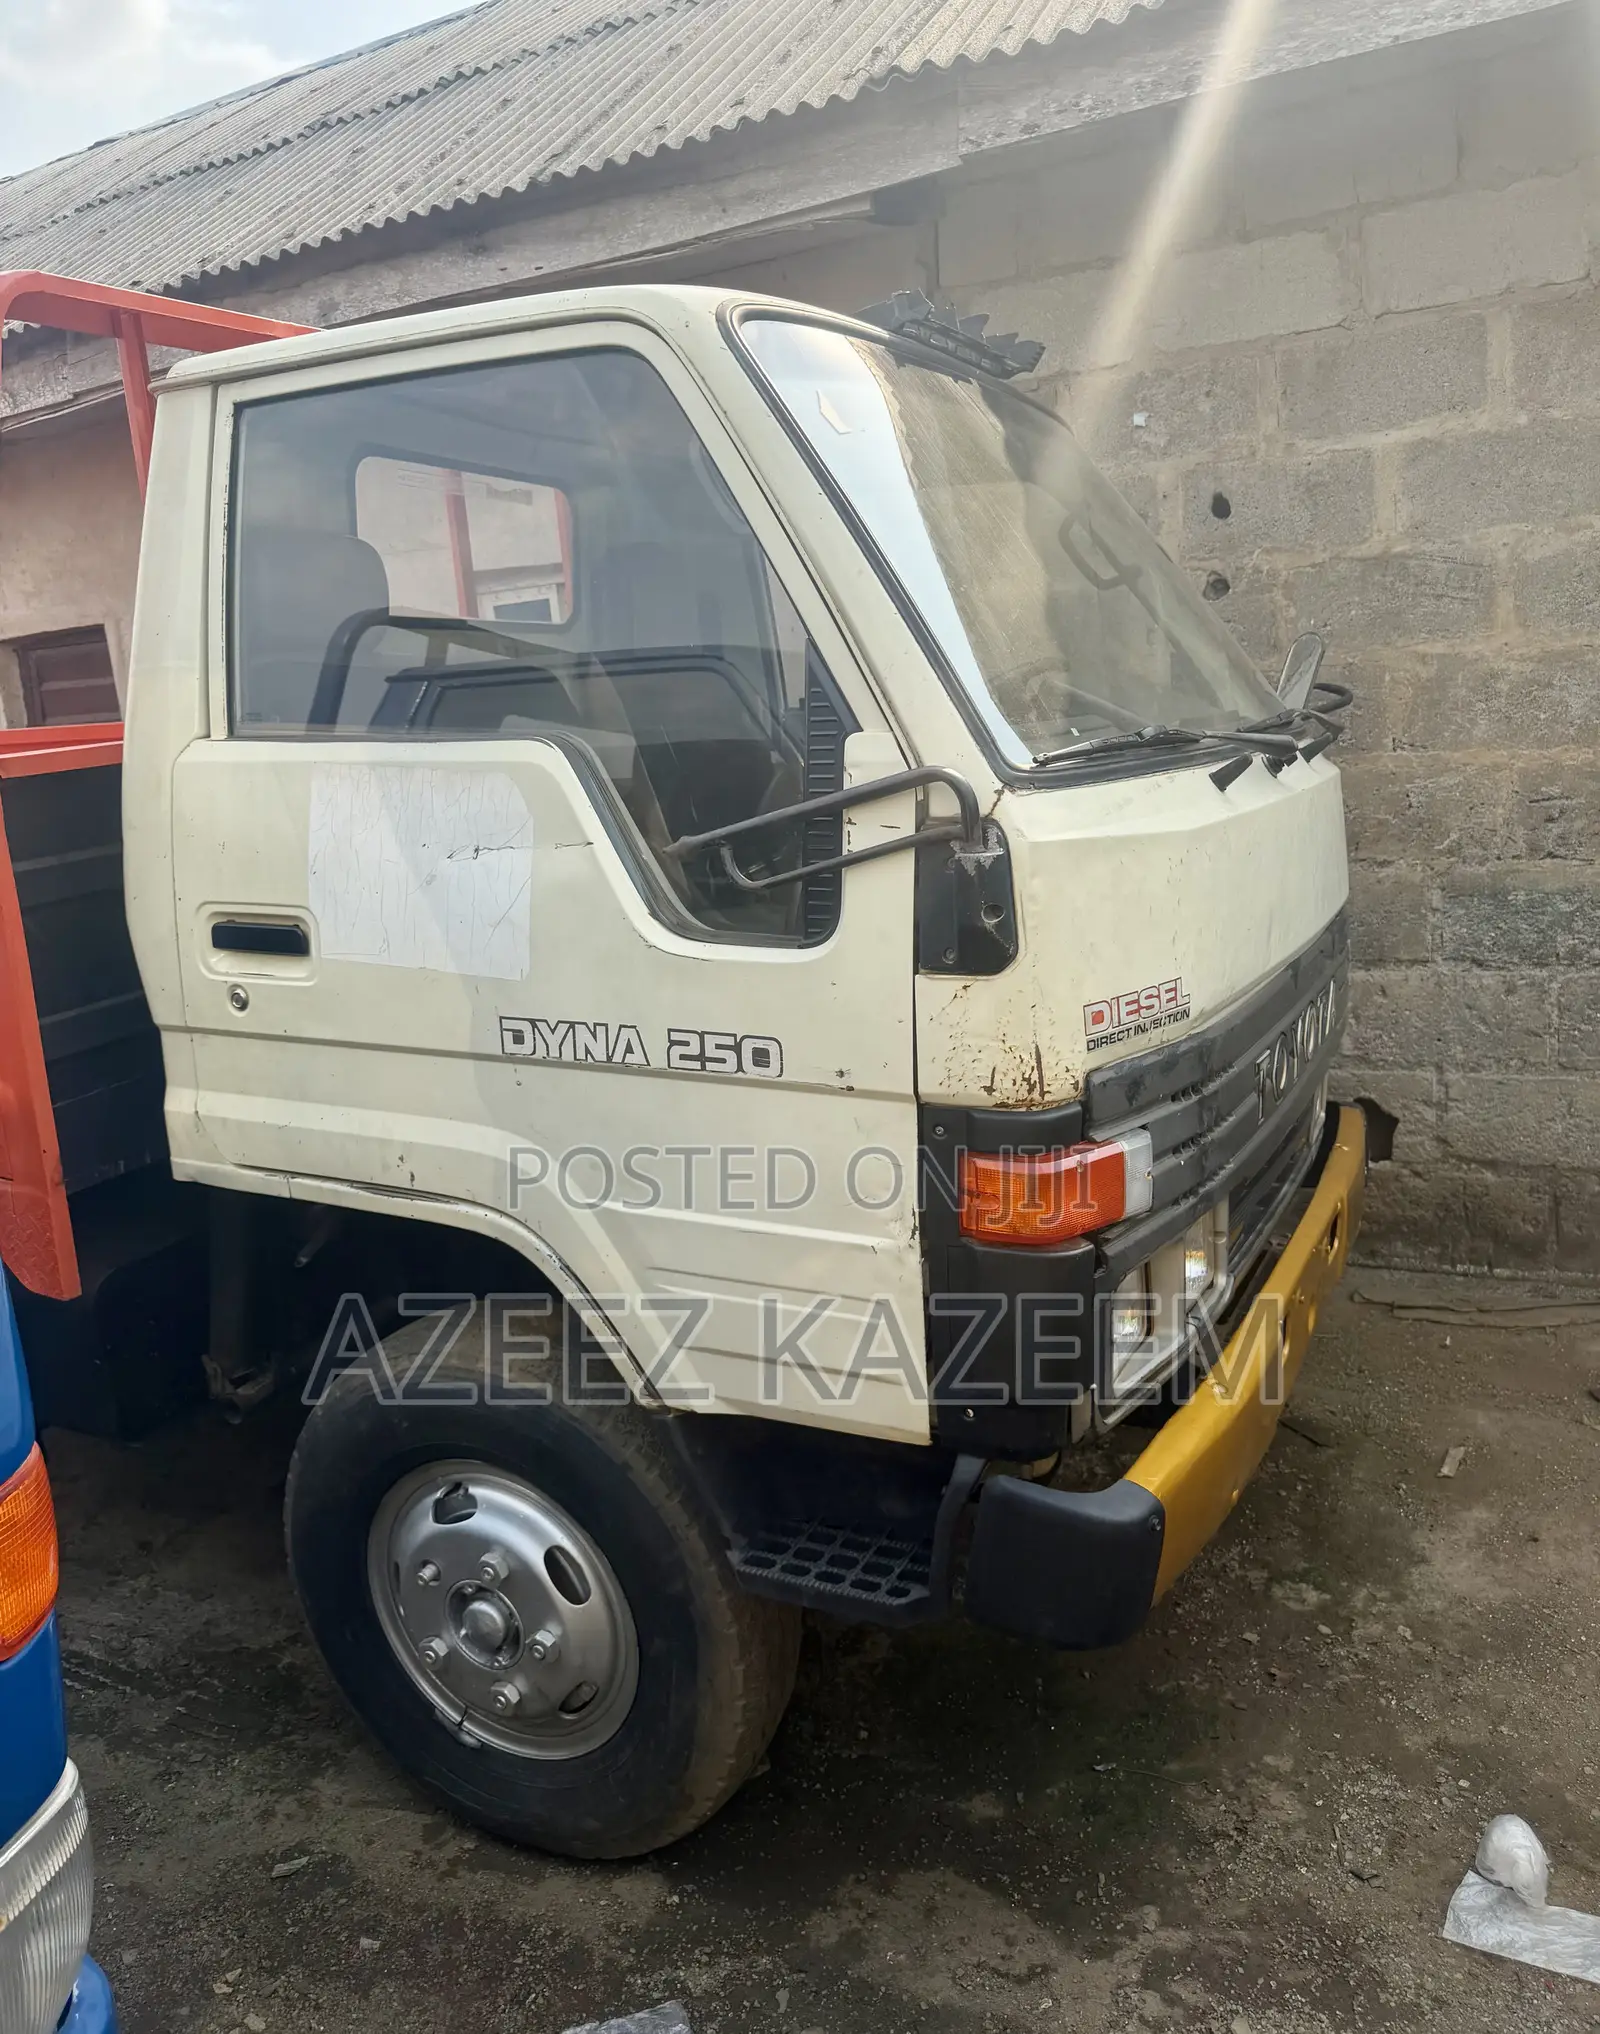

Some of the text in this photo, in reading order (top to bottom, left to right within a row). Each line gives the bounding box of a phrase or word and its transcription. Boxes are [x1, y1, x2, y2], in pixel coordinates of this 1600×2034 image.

[1083, 977, 1190, 1036] DIESEL
[500, 1016, 783, 1078] DYNA 250
[1086, 1028, 1132, 1051] DIRECT
[1255, 978, 1336, 1125] TOYOTA
